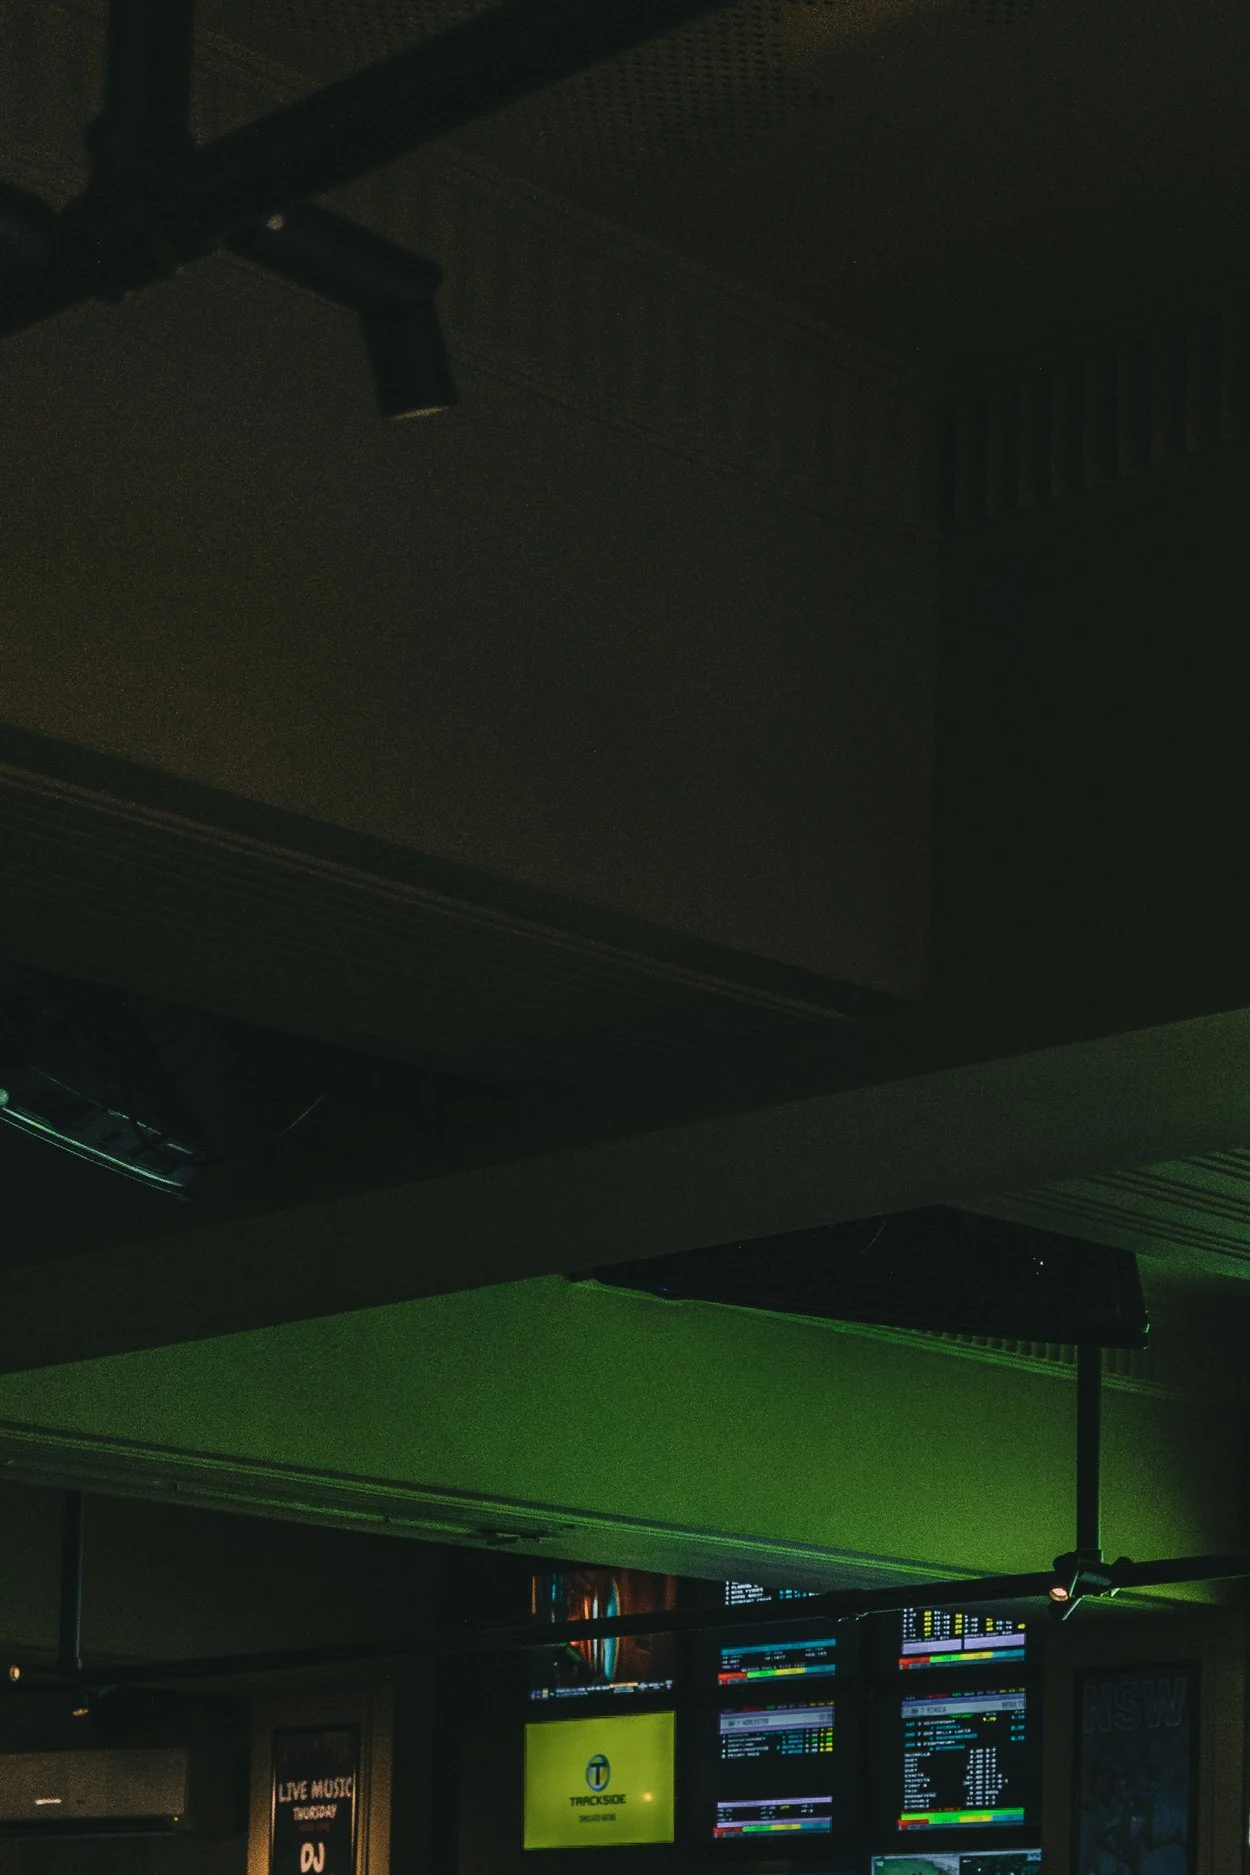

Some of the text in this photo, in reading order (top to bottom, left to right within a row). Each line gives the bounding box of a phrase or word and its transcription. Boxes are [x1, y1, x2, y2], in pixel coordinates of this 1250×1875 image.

[1082, 1676, 1188, 1733] NSW
[278, 1776, 353, 1803] LIVE MUSIC
[569, 1794, 627, 1807] TRACKSIDE
[292, 1804, 338, 1821] THURSDAY
[299, 1841, 326, 1874] DJ
